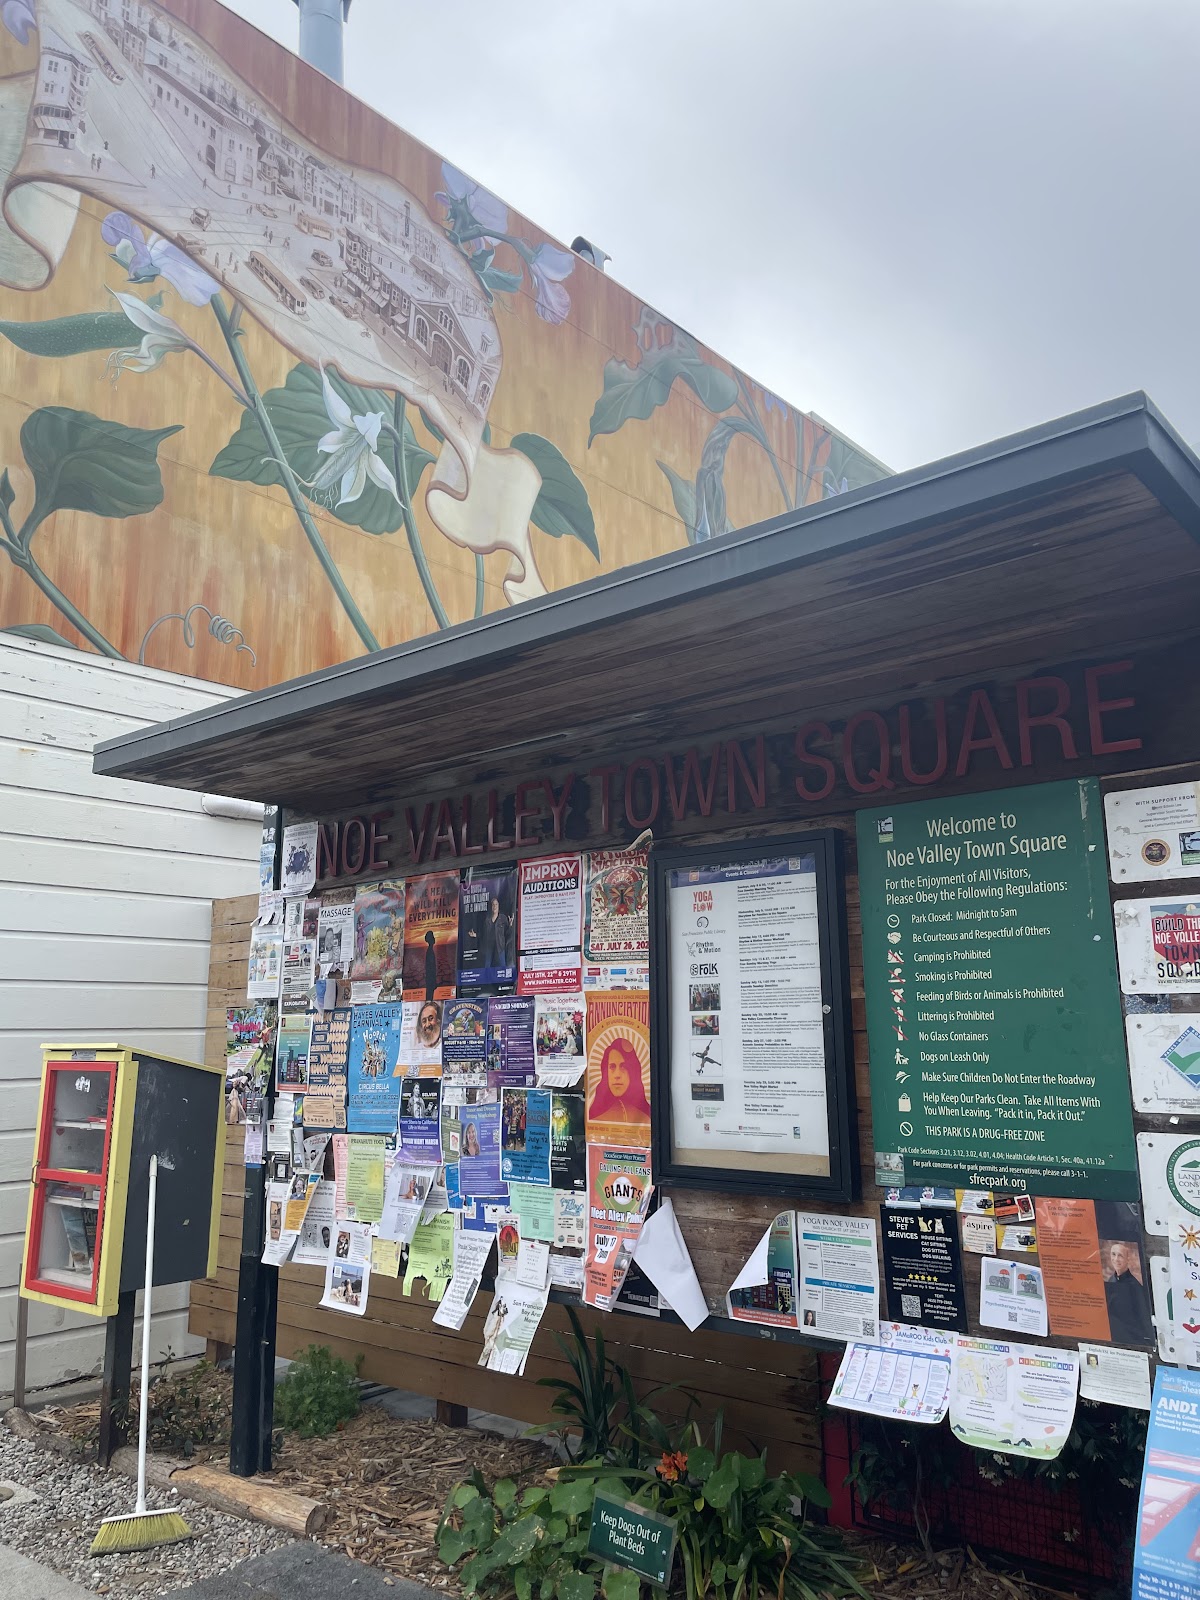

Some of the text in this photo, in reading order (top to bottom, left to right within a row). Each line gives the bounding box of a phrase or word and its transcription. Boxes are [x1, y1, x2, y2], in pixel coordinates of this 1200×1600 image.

[316, 660, 1142, 879] NOE VALLEY TOWN SQUARE
[1151, 797, 1177, 805] SUPPORT
[926, 812, 1017, 838] Welcome to
[886, 833, 1067, 867] Noe Valley Town Square
[525, 861, 577, 881] IMPROV
[885, 866, 1031, 891] For the Enjoyment of All Visitors,
[524, 878, 577, 894] AUDITIONS
[885, 880, 1068, 906] Please Obey the Following Regulations:
[413, 897, 431, 910] WILL
[693, 890, 713, 903] YOGA
[320, 907, 354, 919] MASSAGE
[408, 907, 457, 924] EVERYTHING
[911, 907, 1017, 924] Park Closed: Midnight to 5am
[1155, 918, 1184, 932] BUILD
[912, 926, 1050, 943] Be Courteous and Respectful of Others
[1155, 931, 1200, 944] NOE VALLE
[590, 941, 649, 952] SAT. JULY 26, 202
[1164, 944, 1200, 961] TOWN
[913, 949, 991, 964] Camping is Prohibited
[915, 969, 992, 983] Smoking is Prohibited
[1157, 961, 1200, 978] SQUR
[555, 996, 580, 1006] Together
[916, 987, 1064, 1003] Feeding of Birds or Animals is Prohibited
[354, 1008, 401, 1020] HAYES VALLEY
[588, 1001, 650, 1033] ANNUNCIATIO
[917, 1010, 994, 1024] Littering is Prohibited
[354, 1019, 382, 1028] CARNIVAL
[918, 1031, 989, 1042] No Glass Containers
[920, 1051, 989, 1064] Dogs on Leash Only
[921, 1071, 1096, 1087] Make Sure Children Do Not Enter the Roadway
[922, 1092, 1101, 1108] Help Keep Our Parks Clean. Take All Items With
[923, 1106, 937, 1116] You
[938, 1106, 959, 1117] When
[960, 1106, 992, 1119] Leaving.
[1017, 1108, 1023, 1119] it
[1024, 1108, 1036, 1121] in,
[1037, 1109, 1055, 1120] Pack
[1055, 1109, 1063, 1120] it
[527, 1135, 549, 1144] July 12
[925, 1125, 1045, 1141] THIS PARK IS A DRUG-FREE ZONE
[599, 1162, 651, 1176] CALLING ALL FANS
[969, 1173, 1027, 1190] sfrecpark.org
[605, 1184, 643, 1202] GIANTS
[591, 1207, 625, 1222] Meet Alex
[889, 1215, 914, 1224] STEVE'S
[802, 1216, 870, 1230] YOGA IN NOE VALLEY
[966, 1220, 993, 1231] aspire
[596, 1235, 618, 1247] July 17
[887, 1230, 918, 1240] SERVICES
[922, 1334, 934, 1343] Kids
[934, 1336, 948, 1345] Club
[957, 1340, 1010, 1353] KINDERHAUS
[1018, 1357, 1074, 1371] KINDERHAUS
[1157, 1397, 1198, 1416] ANDI
[600, 1510, 662, 1544] Keep Dogs Out of
[608, 1530, 645, 1555] Plant Beds
